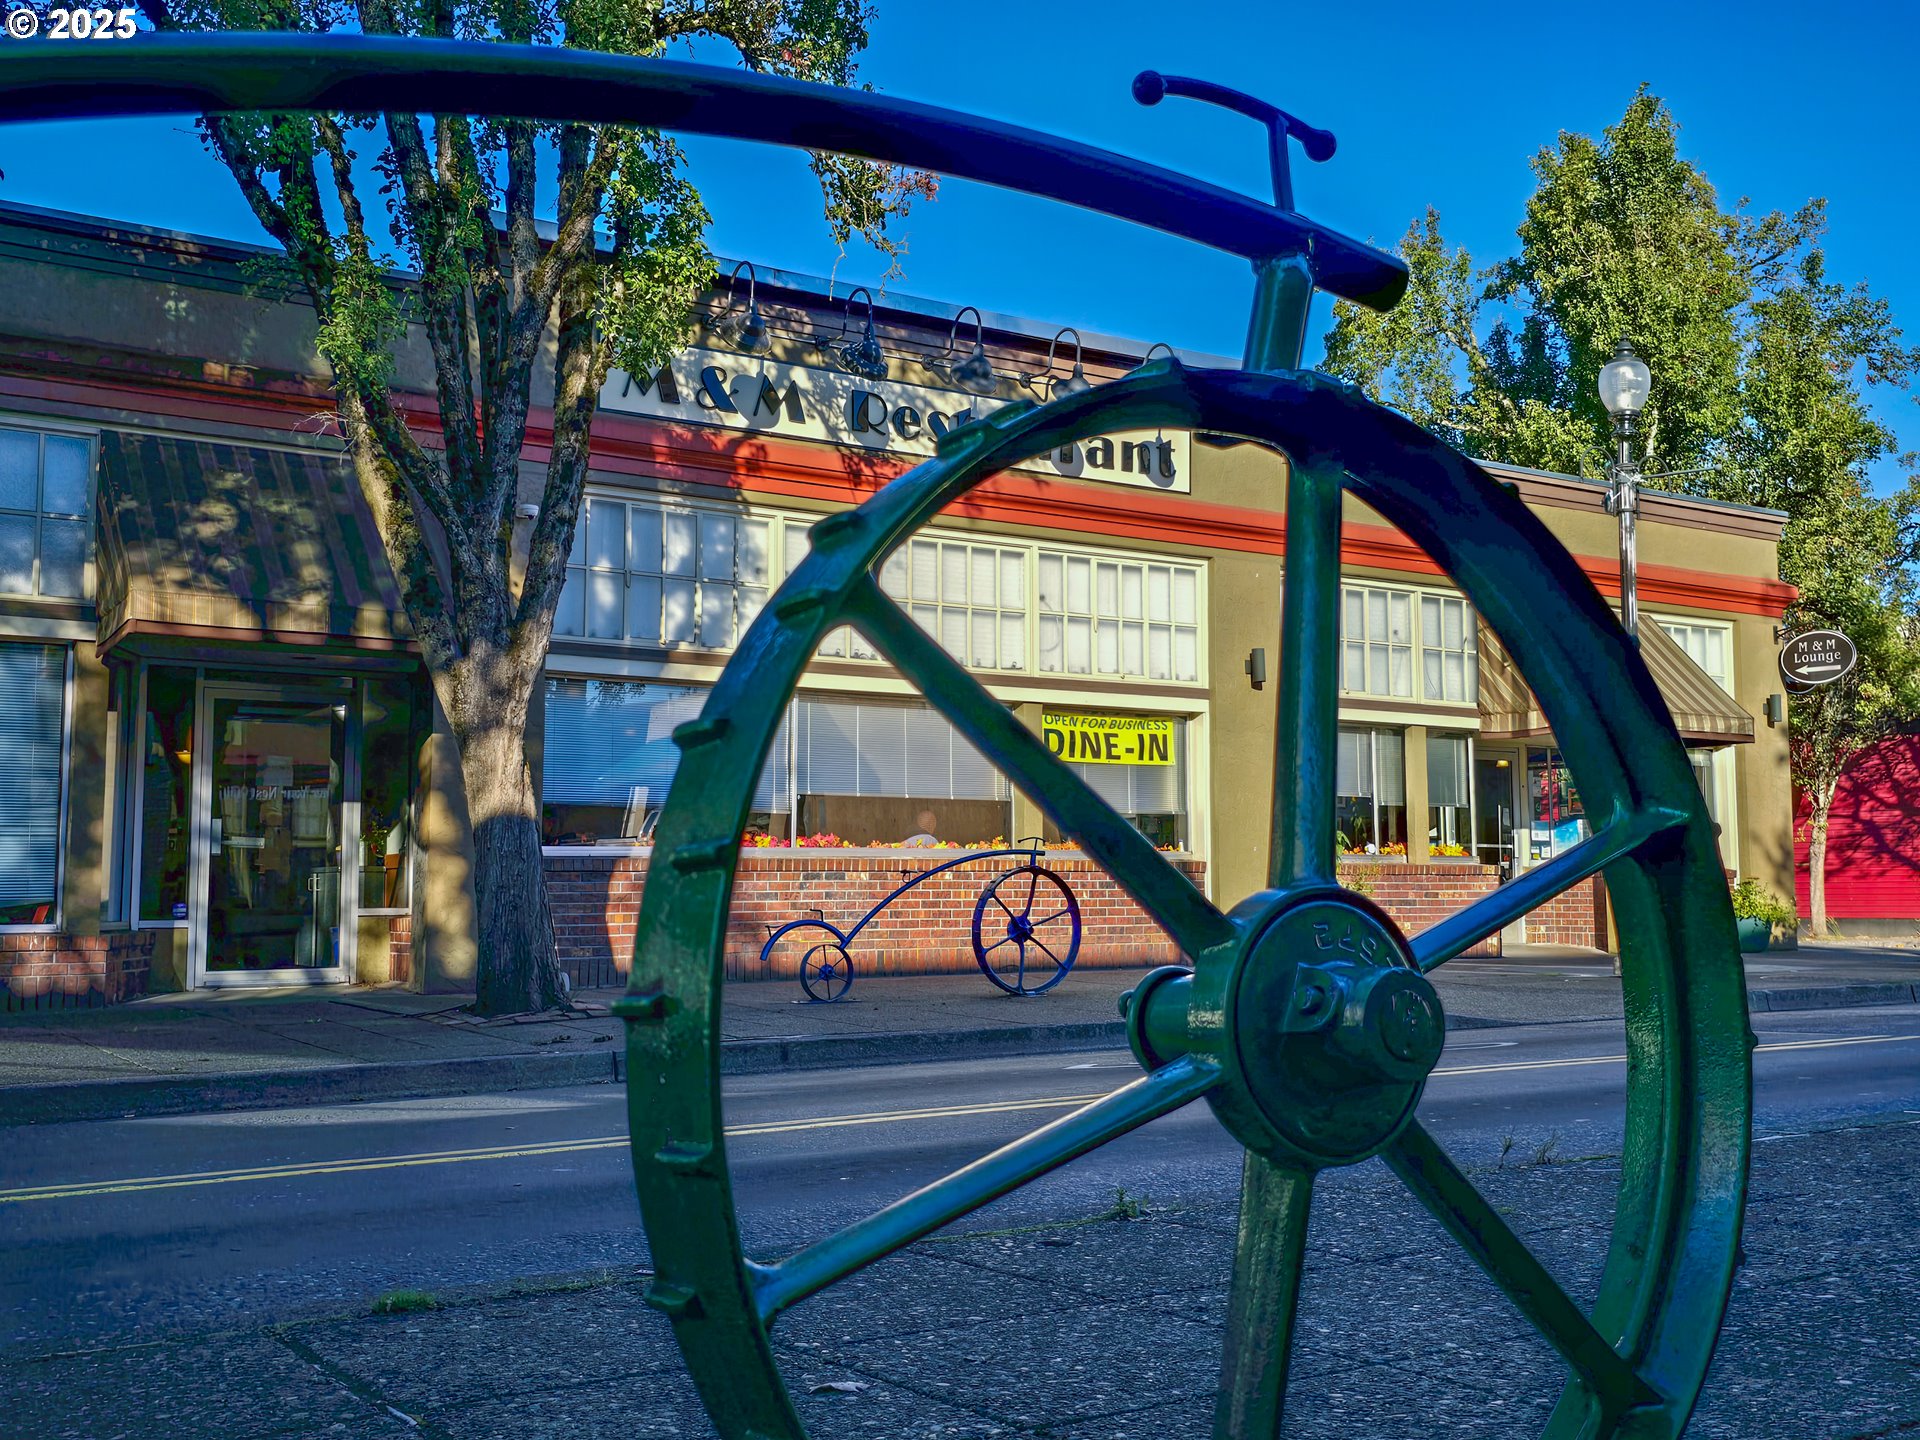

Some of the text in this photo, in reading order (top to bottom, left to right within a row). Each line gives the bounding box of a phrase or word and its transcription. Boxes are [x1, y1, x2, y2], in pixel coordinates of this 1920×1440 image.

[622, 360, 1177, 478] M & M Resant
[1798, 639, 1836, 652] M & M
[1794, 651, 1841, 663] Lounge
[1044, 713, 1169, 731] OPEN FOR BUSINESS
[1043, 727, 1169, 762] DINE-IN
